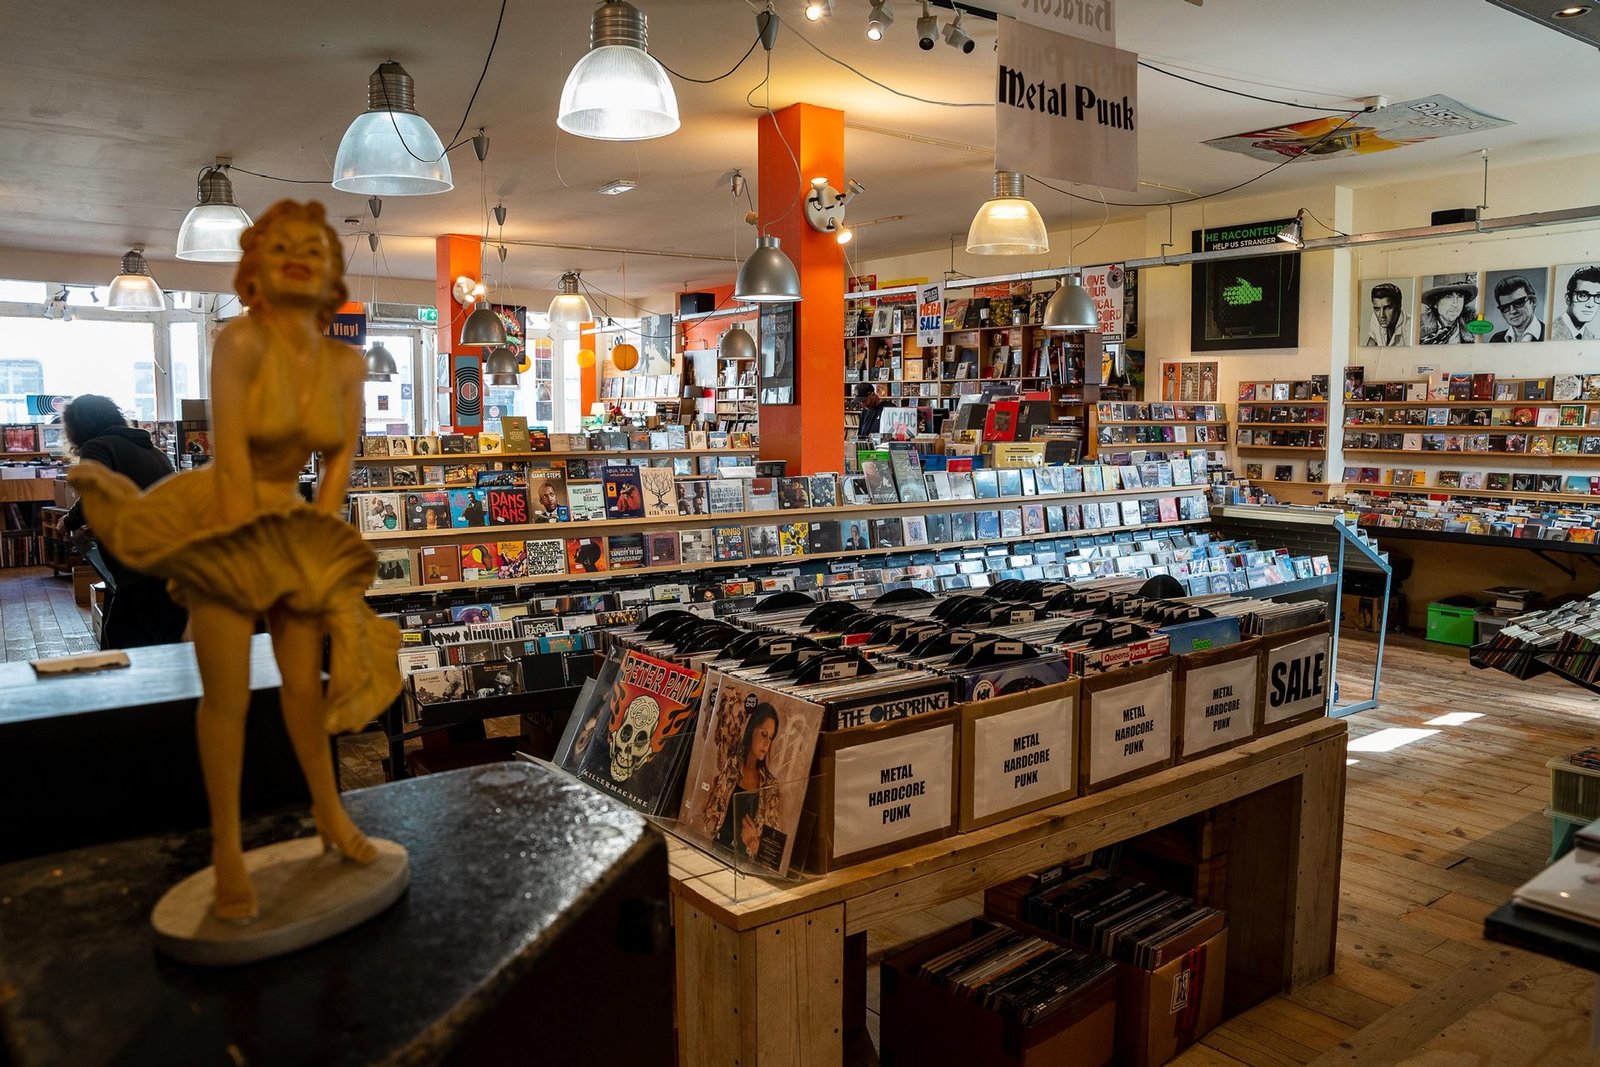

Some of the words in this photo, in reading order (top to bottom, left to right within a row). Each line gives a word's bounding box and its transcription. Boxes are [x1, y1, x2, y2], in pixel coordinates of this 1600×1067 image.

[999, 64, 1067, 118] Metal
[1074, 84, 1135, 131] Punk
[1240, 237, 1276, 247] STRANGER
[920, 302, 942, 317] MEGA
[1096, 309, 1122, 322] CORD
[333, 323, 359, 337] Vinyl
[920, 316, 942, 331] SALE
[490, 490, 525, 511] DANS
[492, 506, 527, 522] DANS
[524, 627, 550, 636] RADIO
[620, 655, 667, 695] PETER
[660, 669, 700, 708] PAN
[1270, 652, 1325, 708] SALE
[1213, 685, 1233, 700] METAL
[1123, 704, 1146, 722] METAL
[1205, 699, 1240, 718] HARDCORE
[1115, 720, 1154, 742] HARDCORE
[1213, 717, 1231, 732] PUNK
[1013, 732, 1040, 753] METAL
[1124, 739, 1144, 757] PUNK
[1003, 748, 1050, 774] HARDCORE
[880, 764, 913, 785] METAL
[1014, 770, 1038, 789] PUNK
[868, 780, 926, 807] HARDCORE
[882, 803, 911, 825] PUNK
